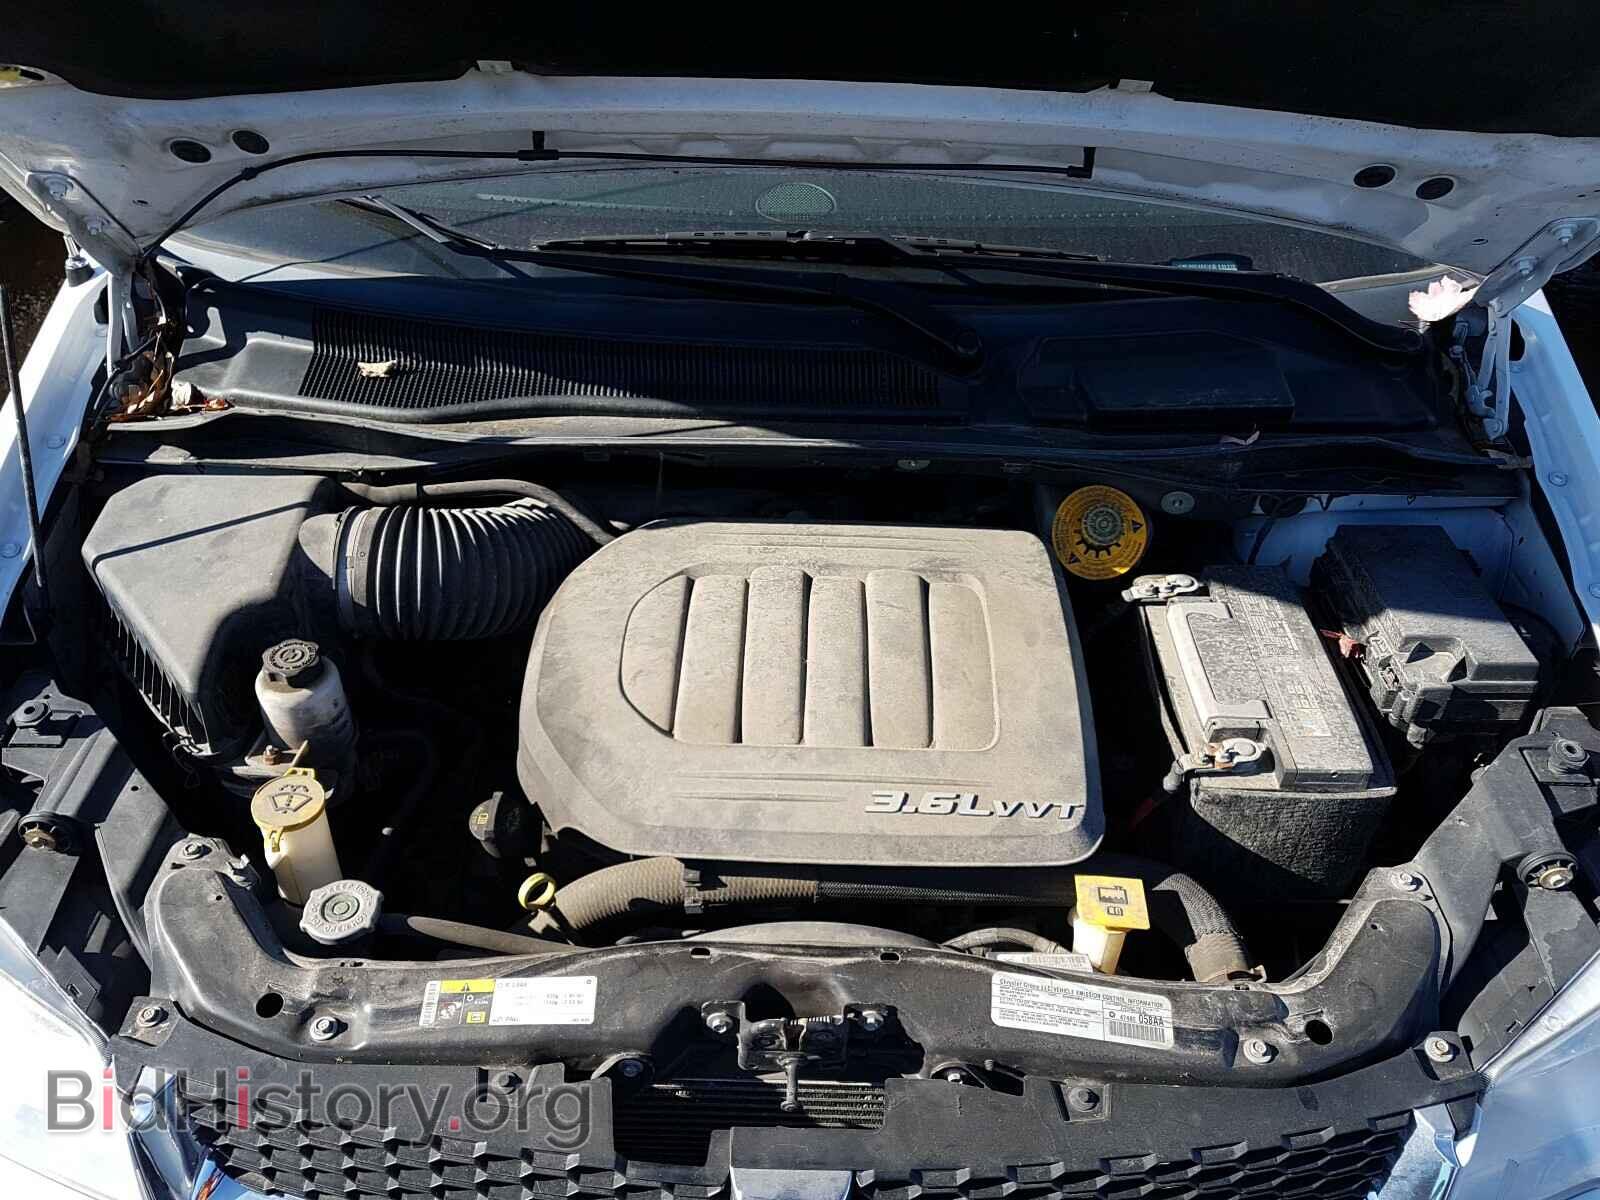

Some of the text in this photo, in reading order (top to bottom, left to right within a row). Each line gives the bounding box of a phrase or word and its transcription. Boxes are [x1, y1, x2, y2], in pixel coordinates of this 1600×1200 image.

[1053, 986, 1074, 996] VEHICLE
[1076, 990, 1101, 999] EMISSION
[1102, 993, 1125, 1003] CONTROL
[1127, 998, 1163, 1008] INFORMATION
[1138, 1014, 1164, 1026] 058AA
